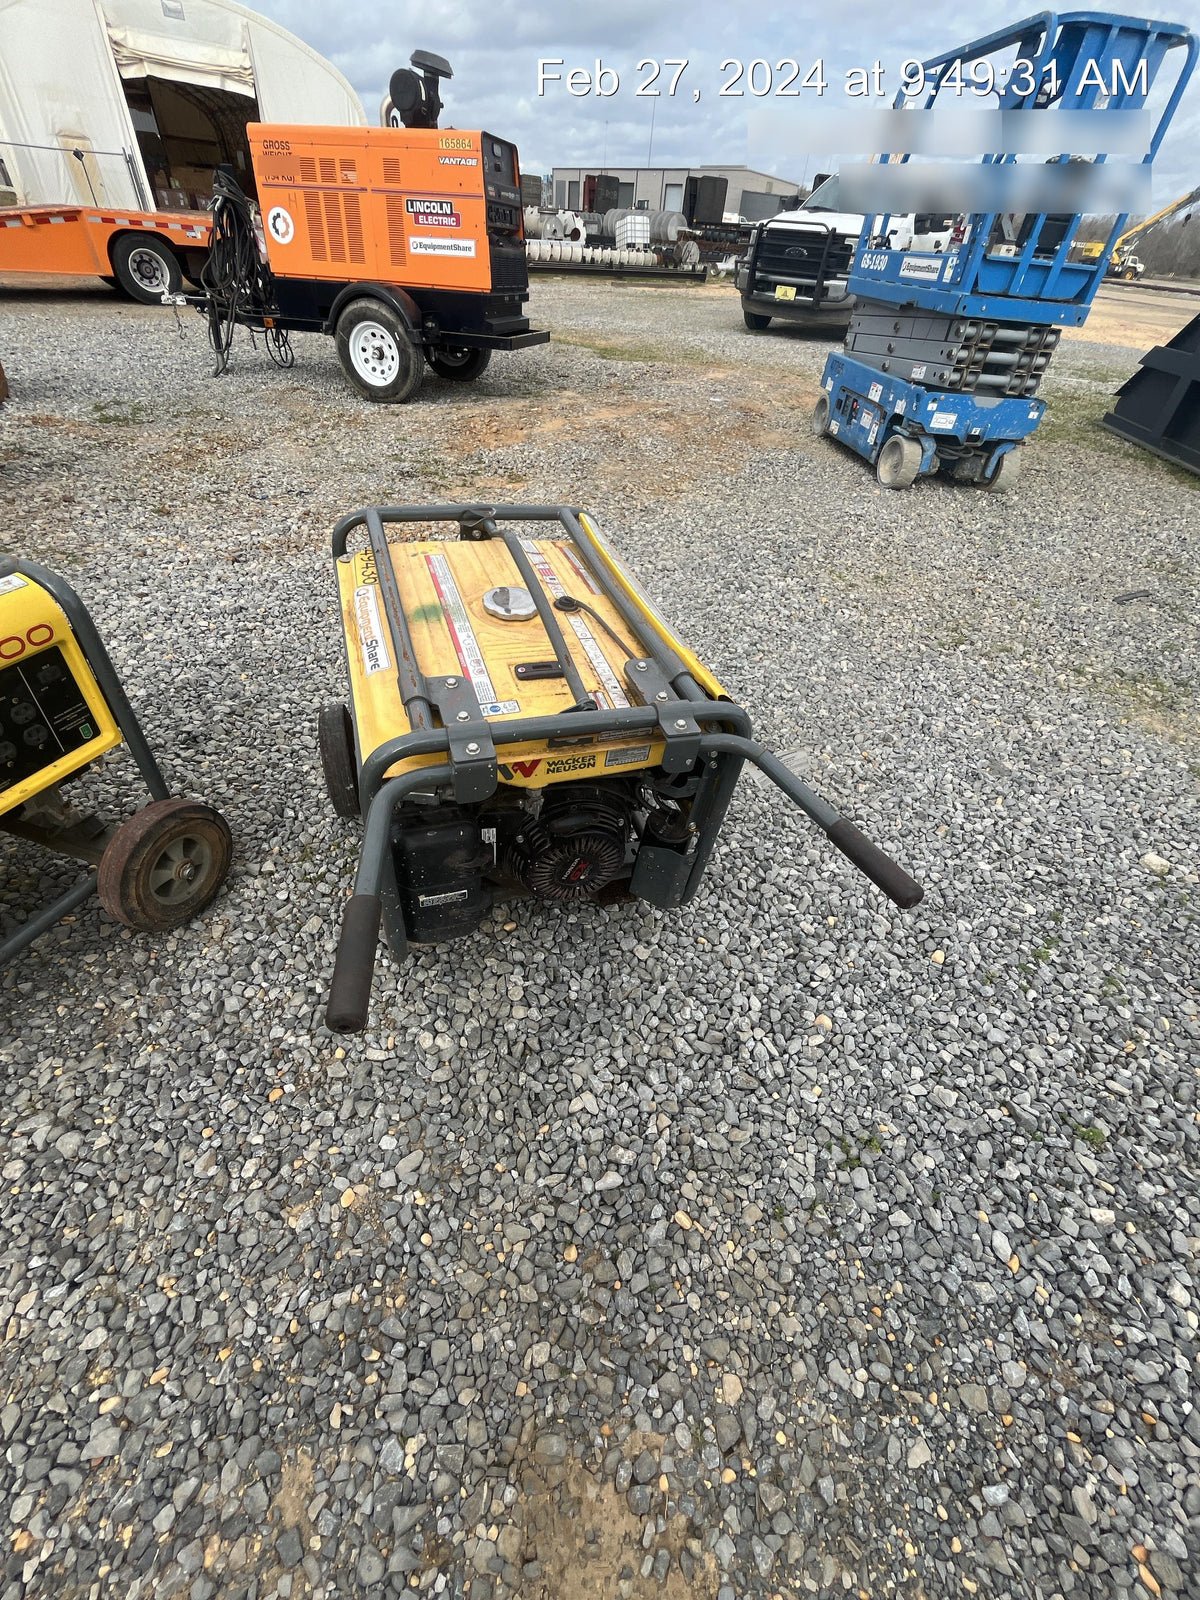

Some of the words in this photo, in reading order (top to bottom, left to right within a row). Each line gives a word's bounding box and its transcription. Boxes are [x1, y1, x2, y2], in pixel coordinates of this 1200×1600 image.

[262, 139, 291, 151] GROSS
[439, 137, 472, 150] 165864
[438, 156, 478, 167] VANTAGE
[407, 200, 452, 215] LINCOLN
[418, 215, 457, 226] ELECTRIC
[418, 241, 472, 252] EquipmentShare
[860, 253, 889, 272] GS-1930
[359, 595, 380, 671] EquipmentShare
[546, 755, 596, 767] WACKER
[546, 762, 596, 774] NEUSON
